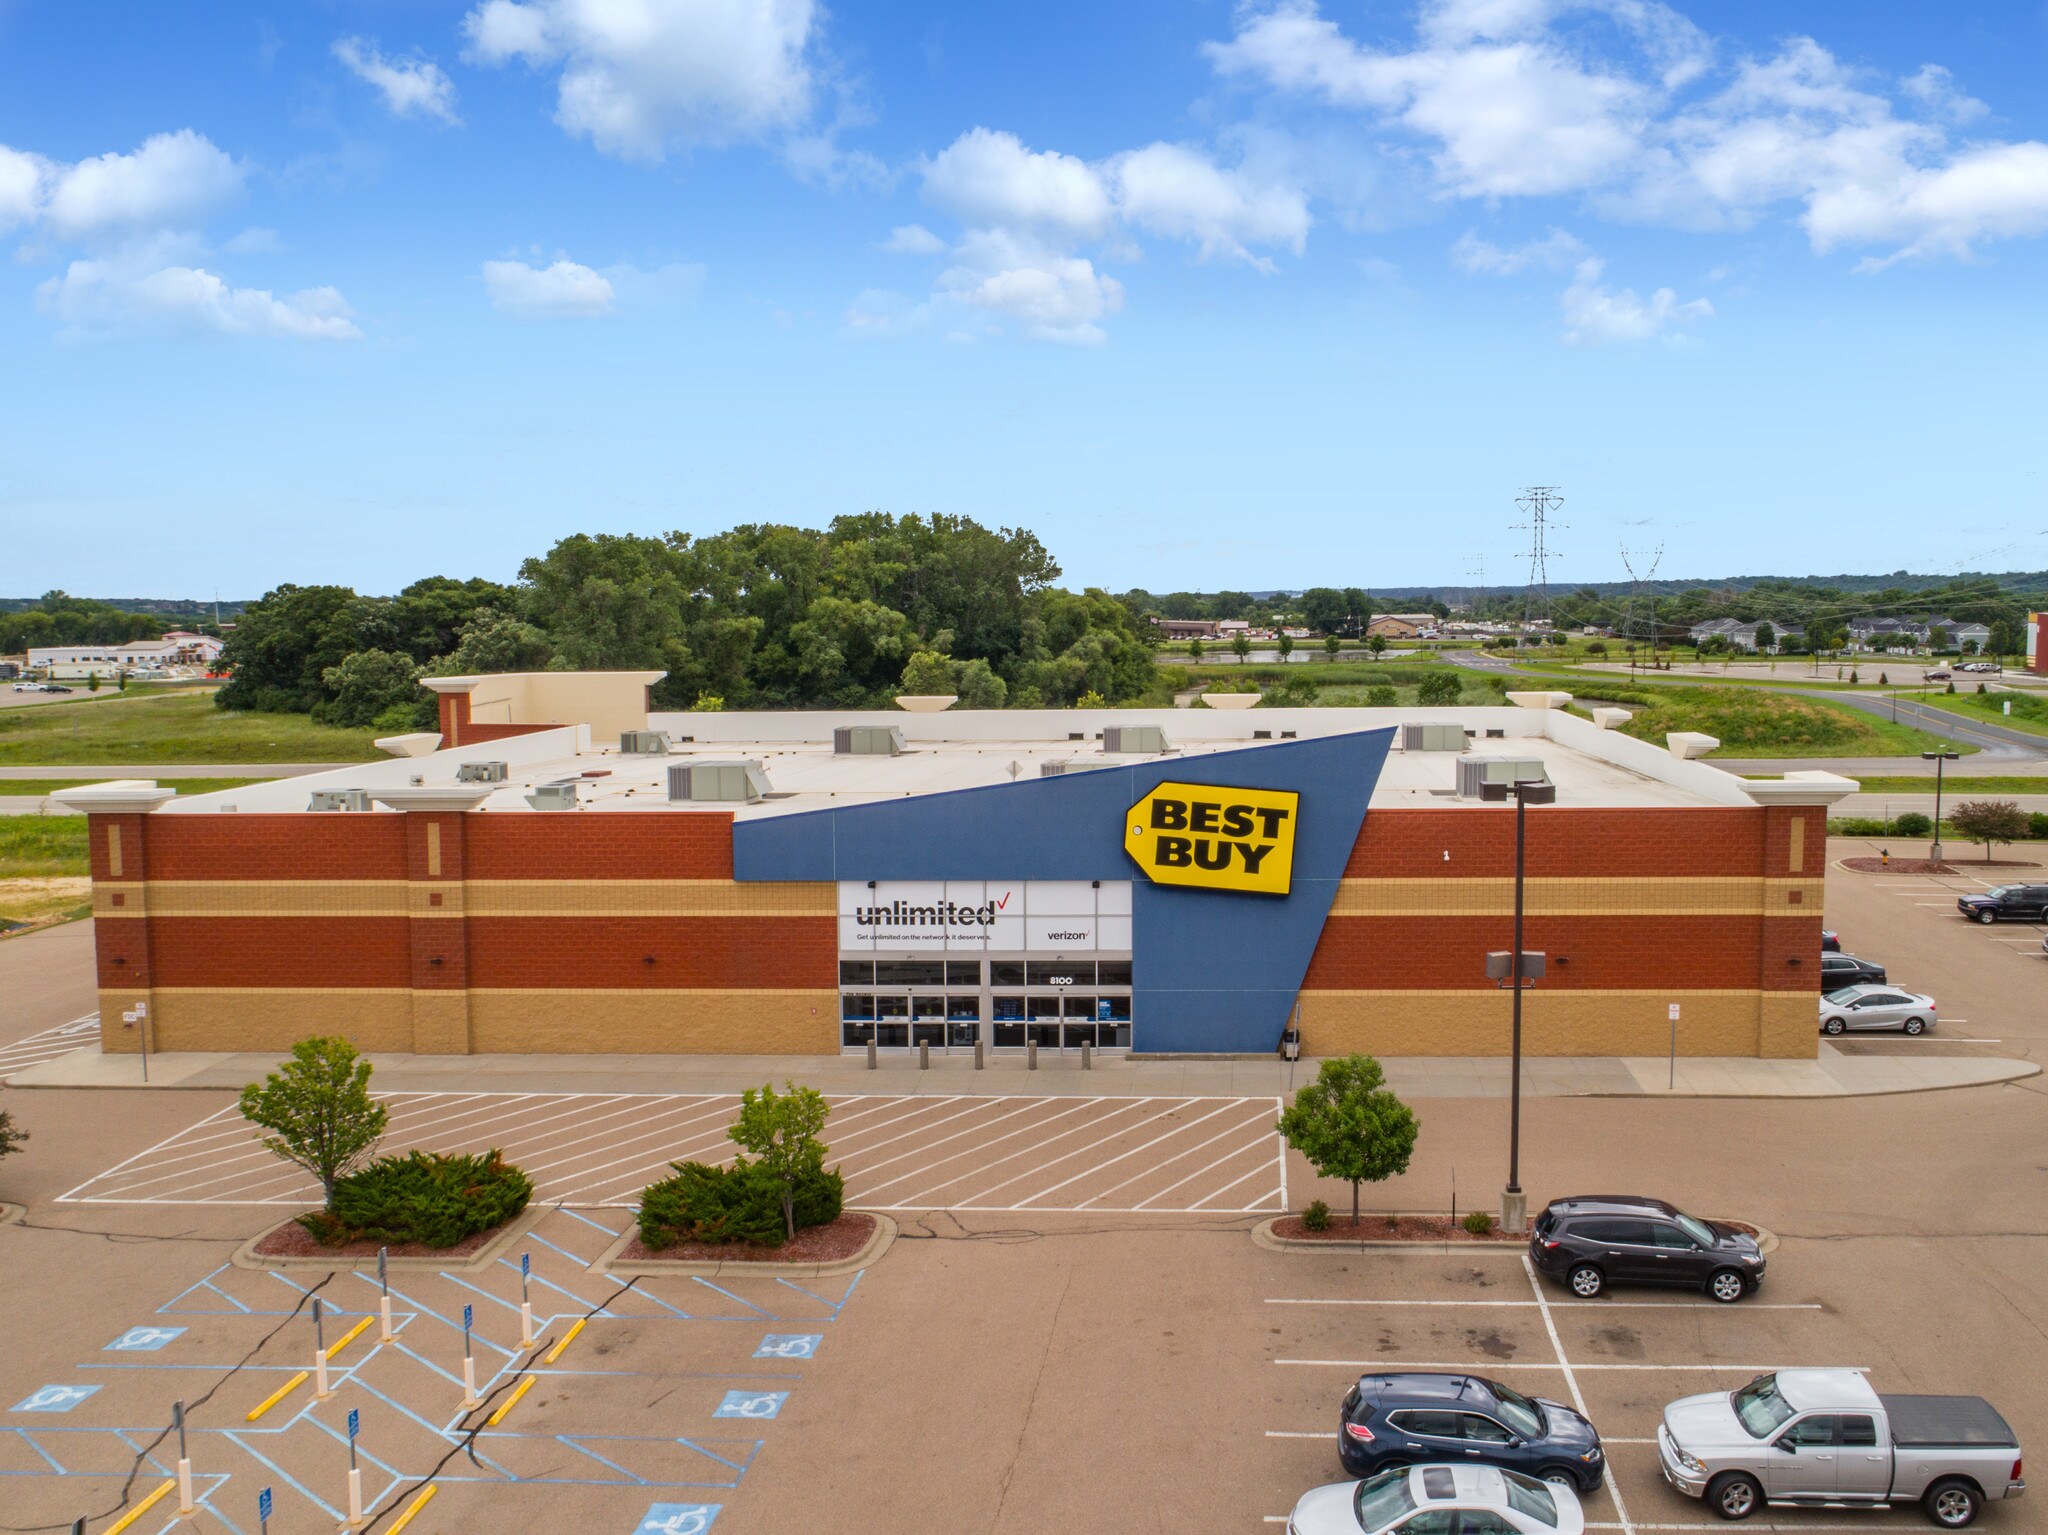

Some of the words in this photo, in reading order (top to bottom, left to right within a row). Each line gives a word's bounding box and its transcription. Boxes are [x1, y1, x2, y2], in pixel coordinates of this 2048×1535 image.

[1151, 798, 1289, 839] BEST
[1155, 835, 1275, 874] BUY
[856, 900, 995, 926] unlimited
[921, 933, 951, 941] network
[1047, 930, 1086, 940] verizon
[1050, 976, 1073, 985] 8100
